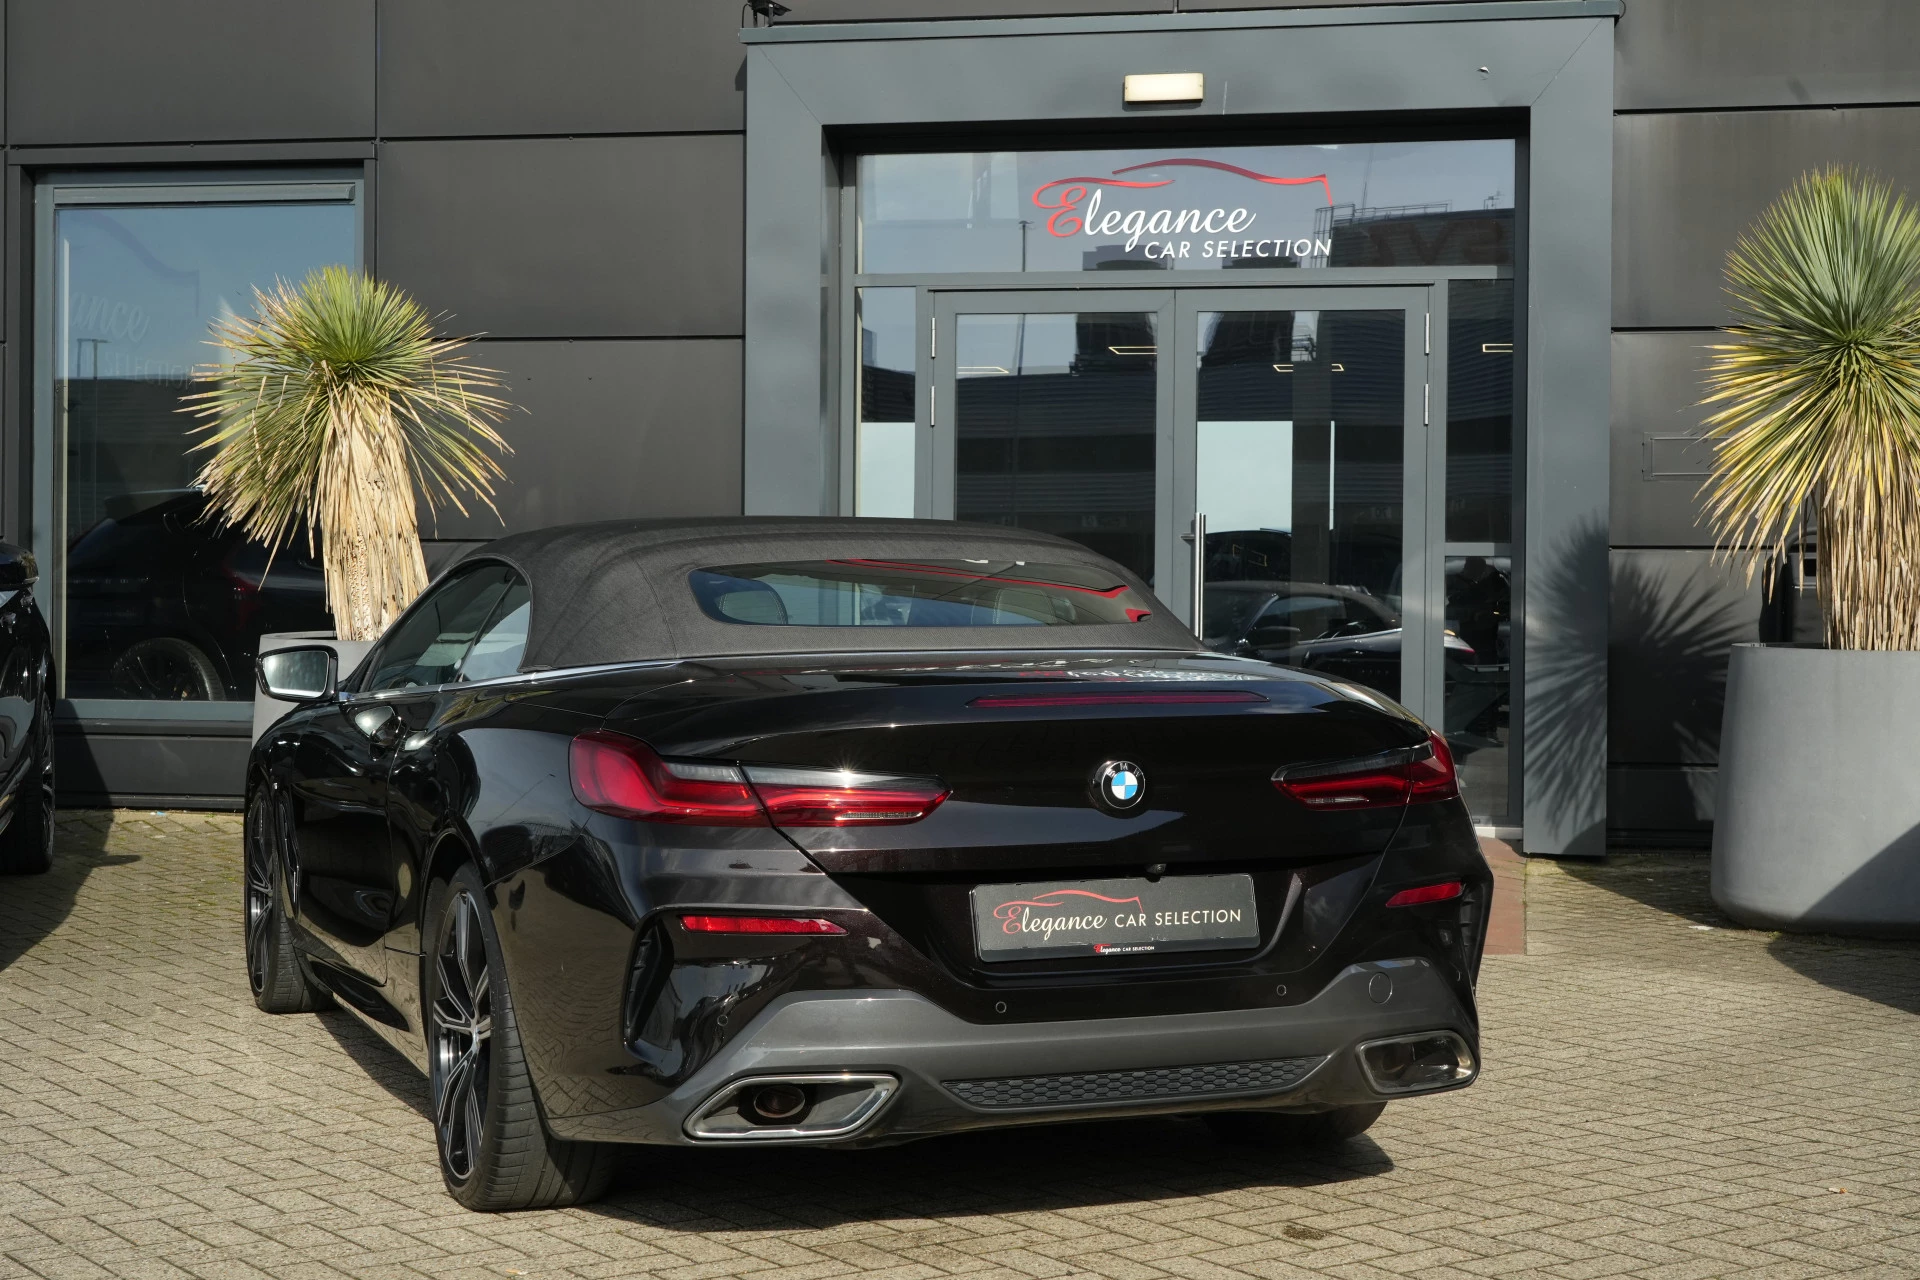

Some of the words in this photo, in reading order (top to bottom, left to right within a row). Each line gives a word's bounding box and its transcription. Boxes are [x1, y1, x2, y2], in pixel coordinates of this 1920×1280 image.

[1032, 180, 1256, 253] Elegance
[1144, 240, 1191, 260] CAR
[1201, 237, 1332, 259] SELECTION
[993, 903, 1107, 940] Elegance
[1115, 914, 1147, 928] CAR
[1154, 909, 1242, 927] SELECTION
[1093, 944, 1121, 954] Elegance
